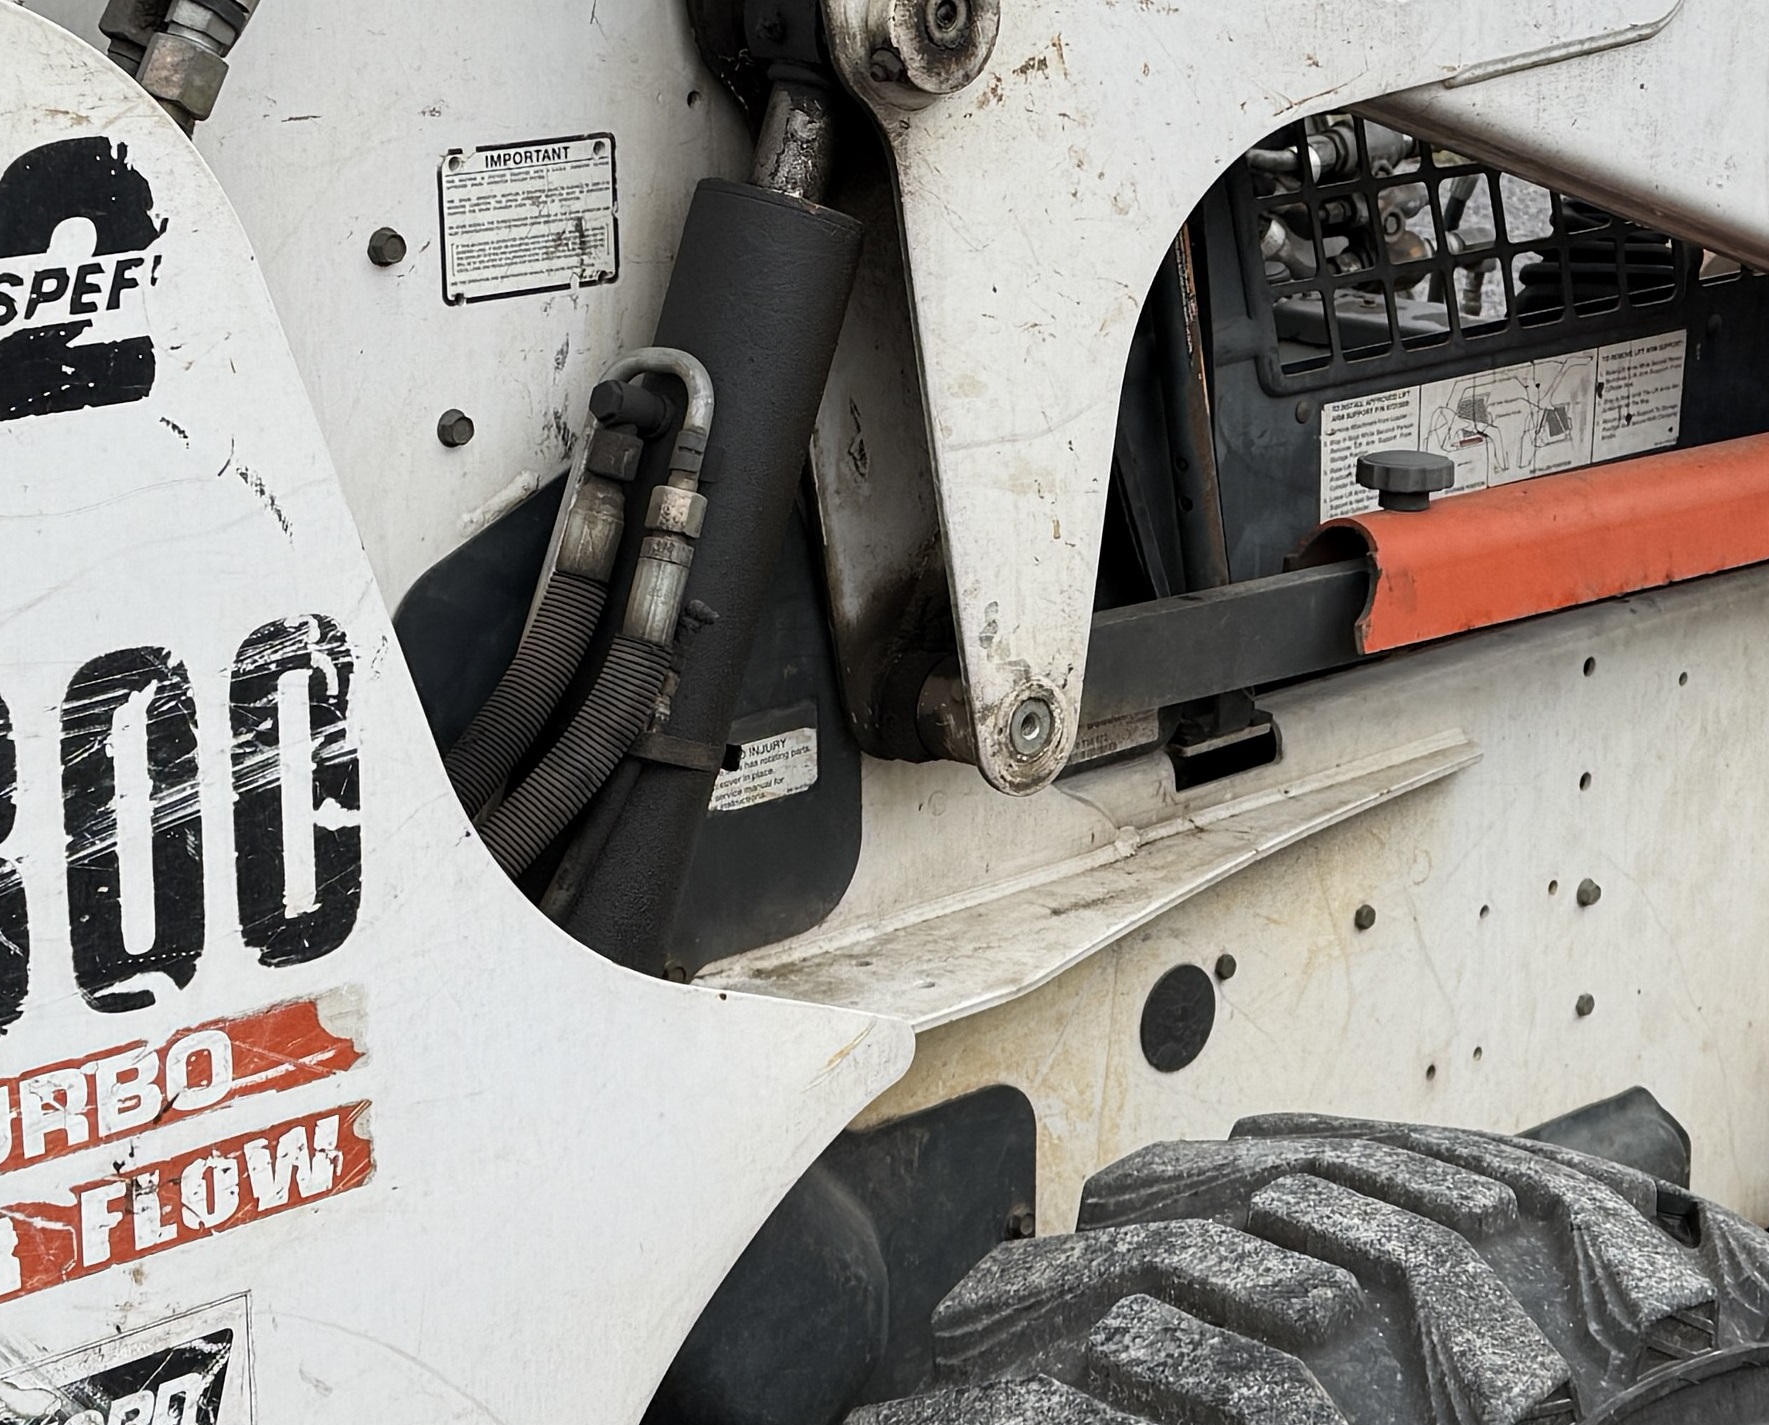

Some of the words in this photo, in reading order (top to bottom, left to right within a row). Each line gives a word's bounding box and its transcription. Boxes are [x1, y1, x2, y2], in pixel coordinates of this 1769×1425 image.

[485, 146, 570, 168] IMPORTANT
[749, 738, 788, 758] INJURY
[78, 1115, 344, 1268] FLOW
